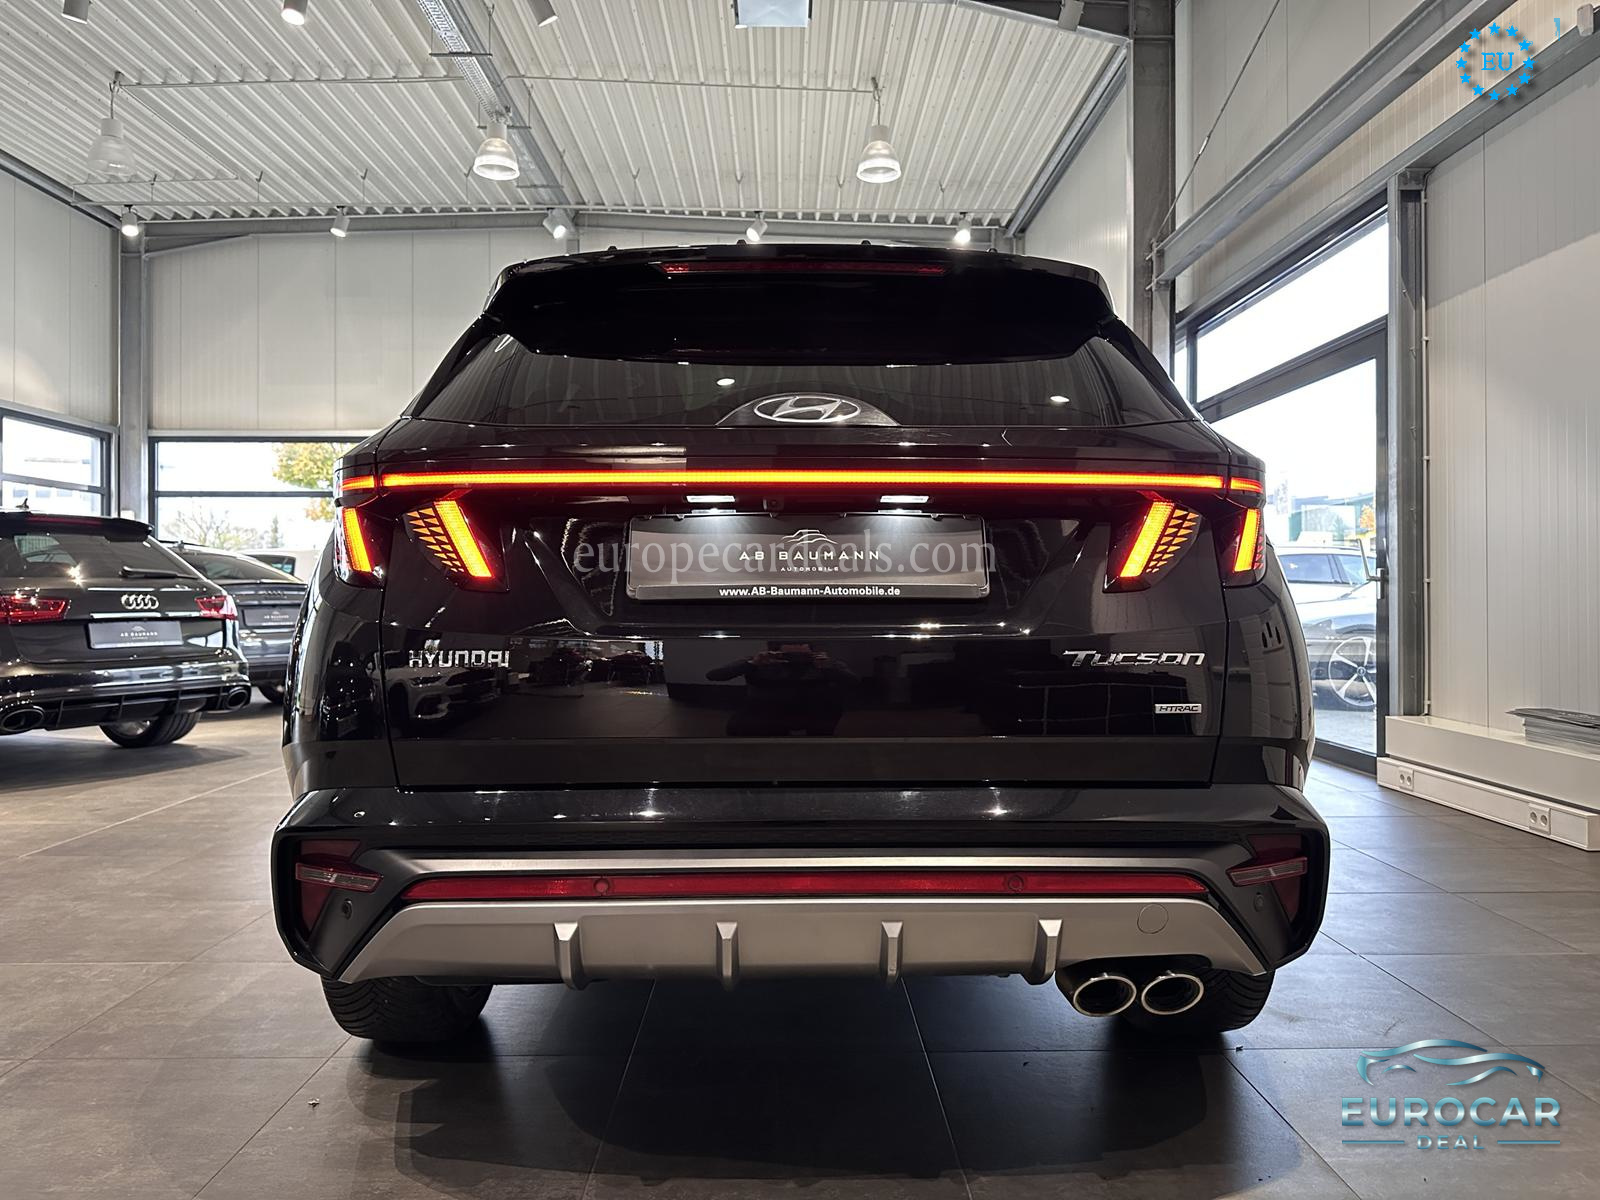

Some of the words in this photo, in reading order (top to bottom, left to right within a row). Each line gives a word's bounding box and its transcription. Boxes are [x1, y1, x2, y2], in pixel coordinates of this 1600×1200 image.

[739, 551, 765, 561] AB
[779, 550, 880, 561] BAUMANN
[719, 585, 901, 597] www.AB-Baumann-Automobile.de
[408, 649, 510, 668] HYUNDAI
